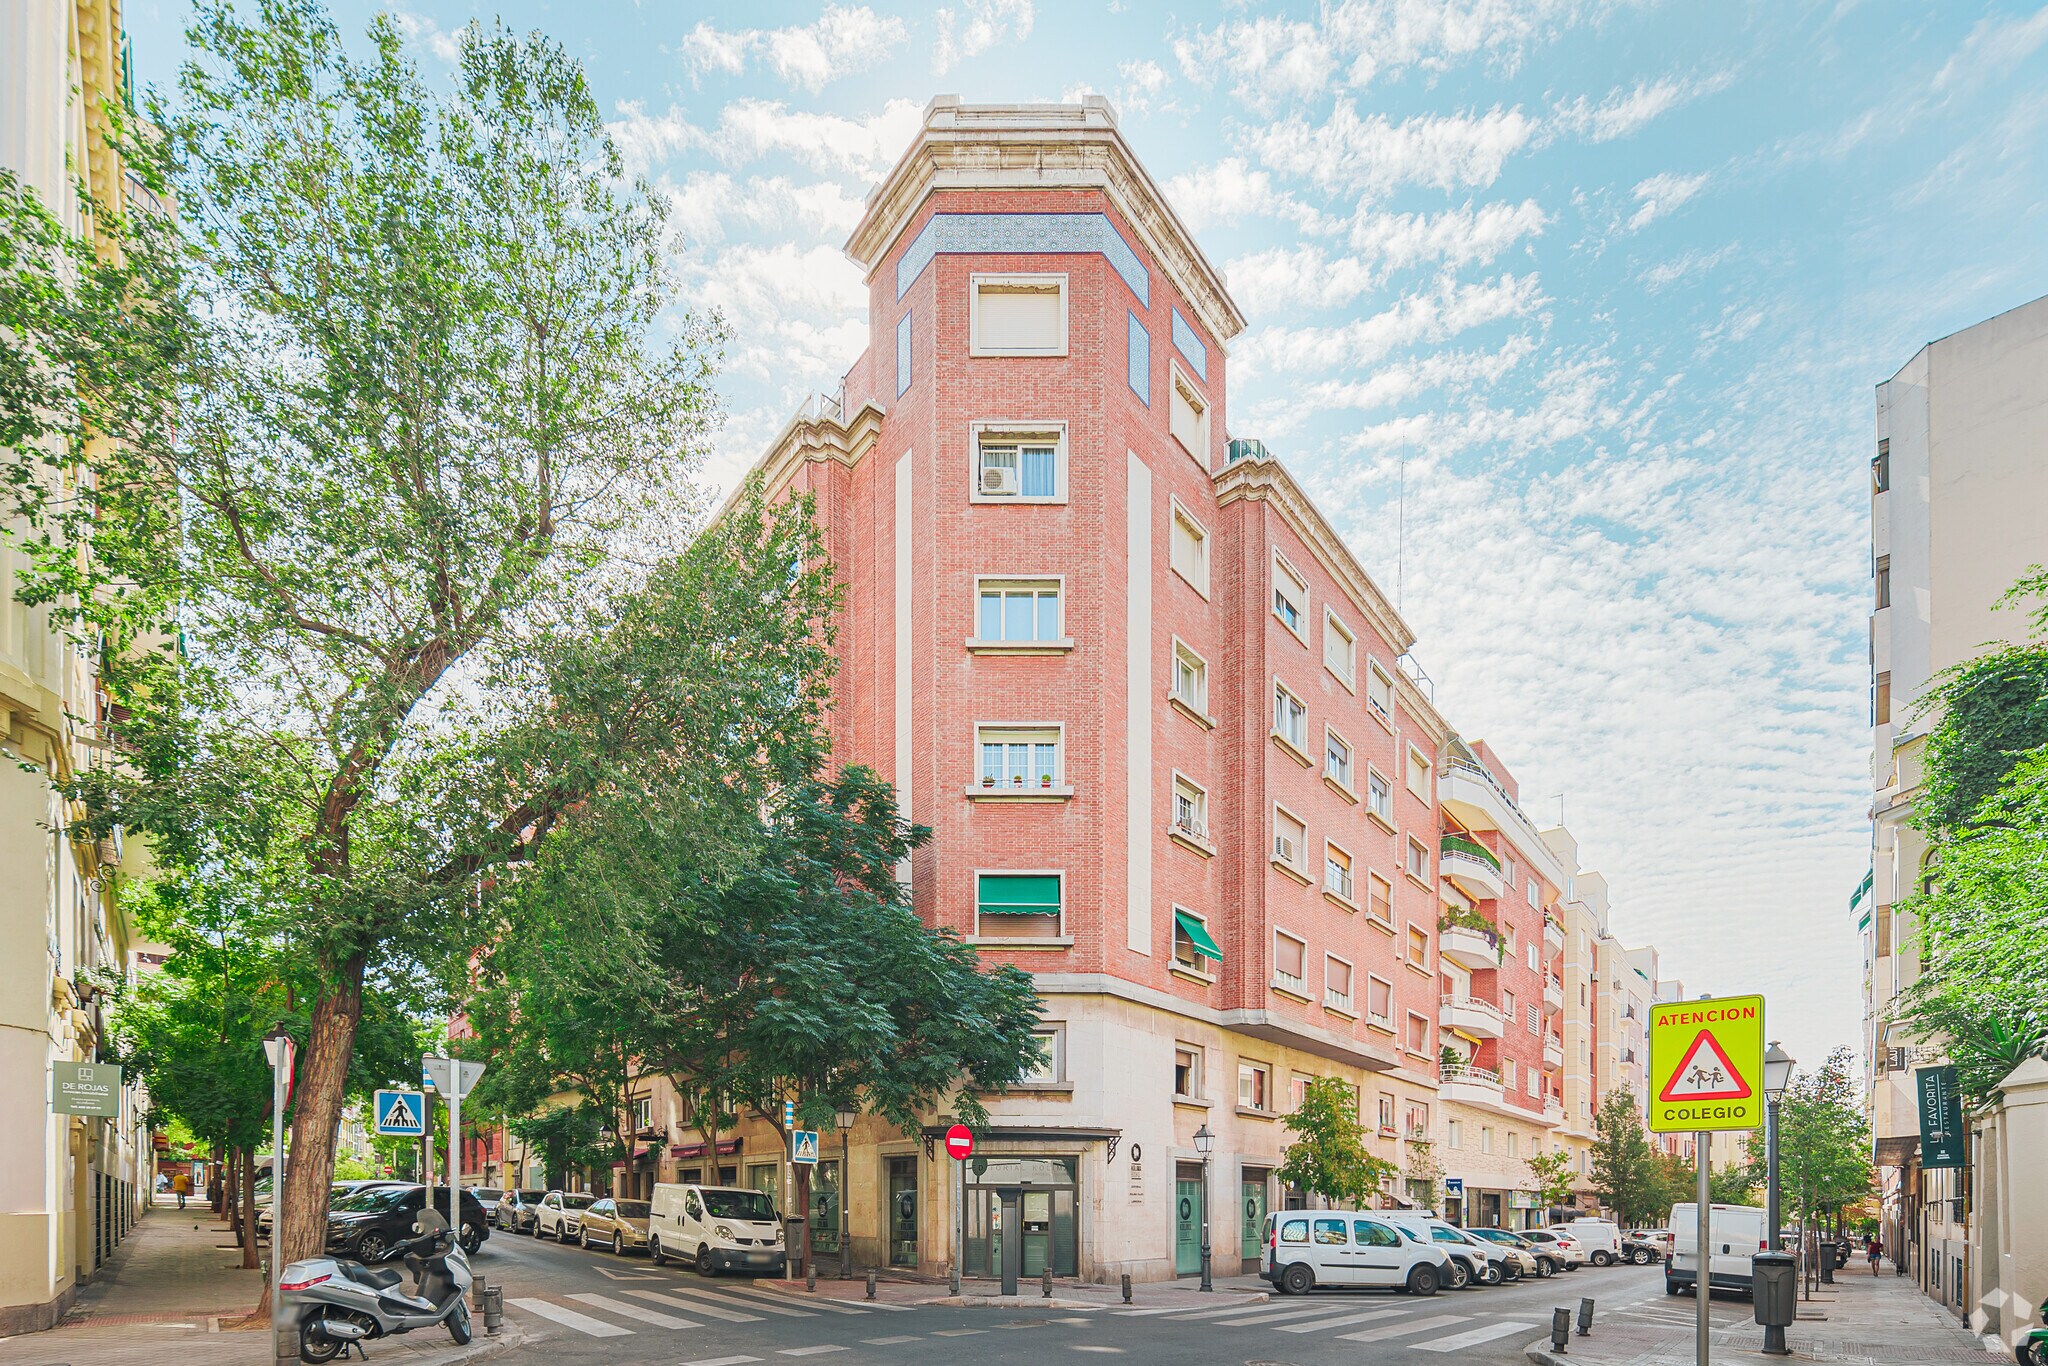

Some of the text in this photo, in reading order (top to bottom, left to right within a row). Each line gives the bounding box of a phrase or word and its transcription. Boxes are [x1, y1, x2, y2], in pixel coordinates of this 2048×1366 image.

[1657, 1006, 1755, 1027] ATENCION
[62, 1082, 109, 1092] DE ROJAS
[1925, 1075, 1938, 1126] FAVORITA
[1663, 1106, 1747, 1121] COLEGIO
[972, 1164, 1026, 1172] EDTORIAL
